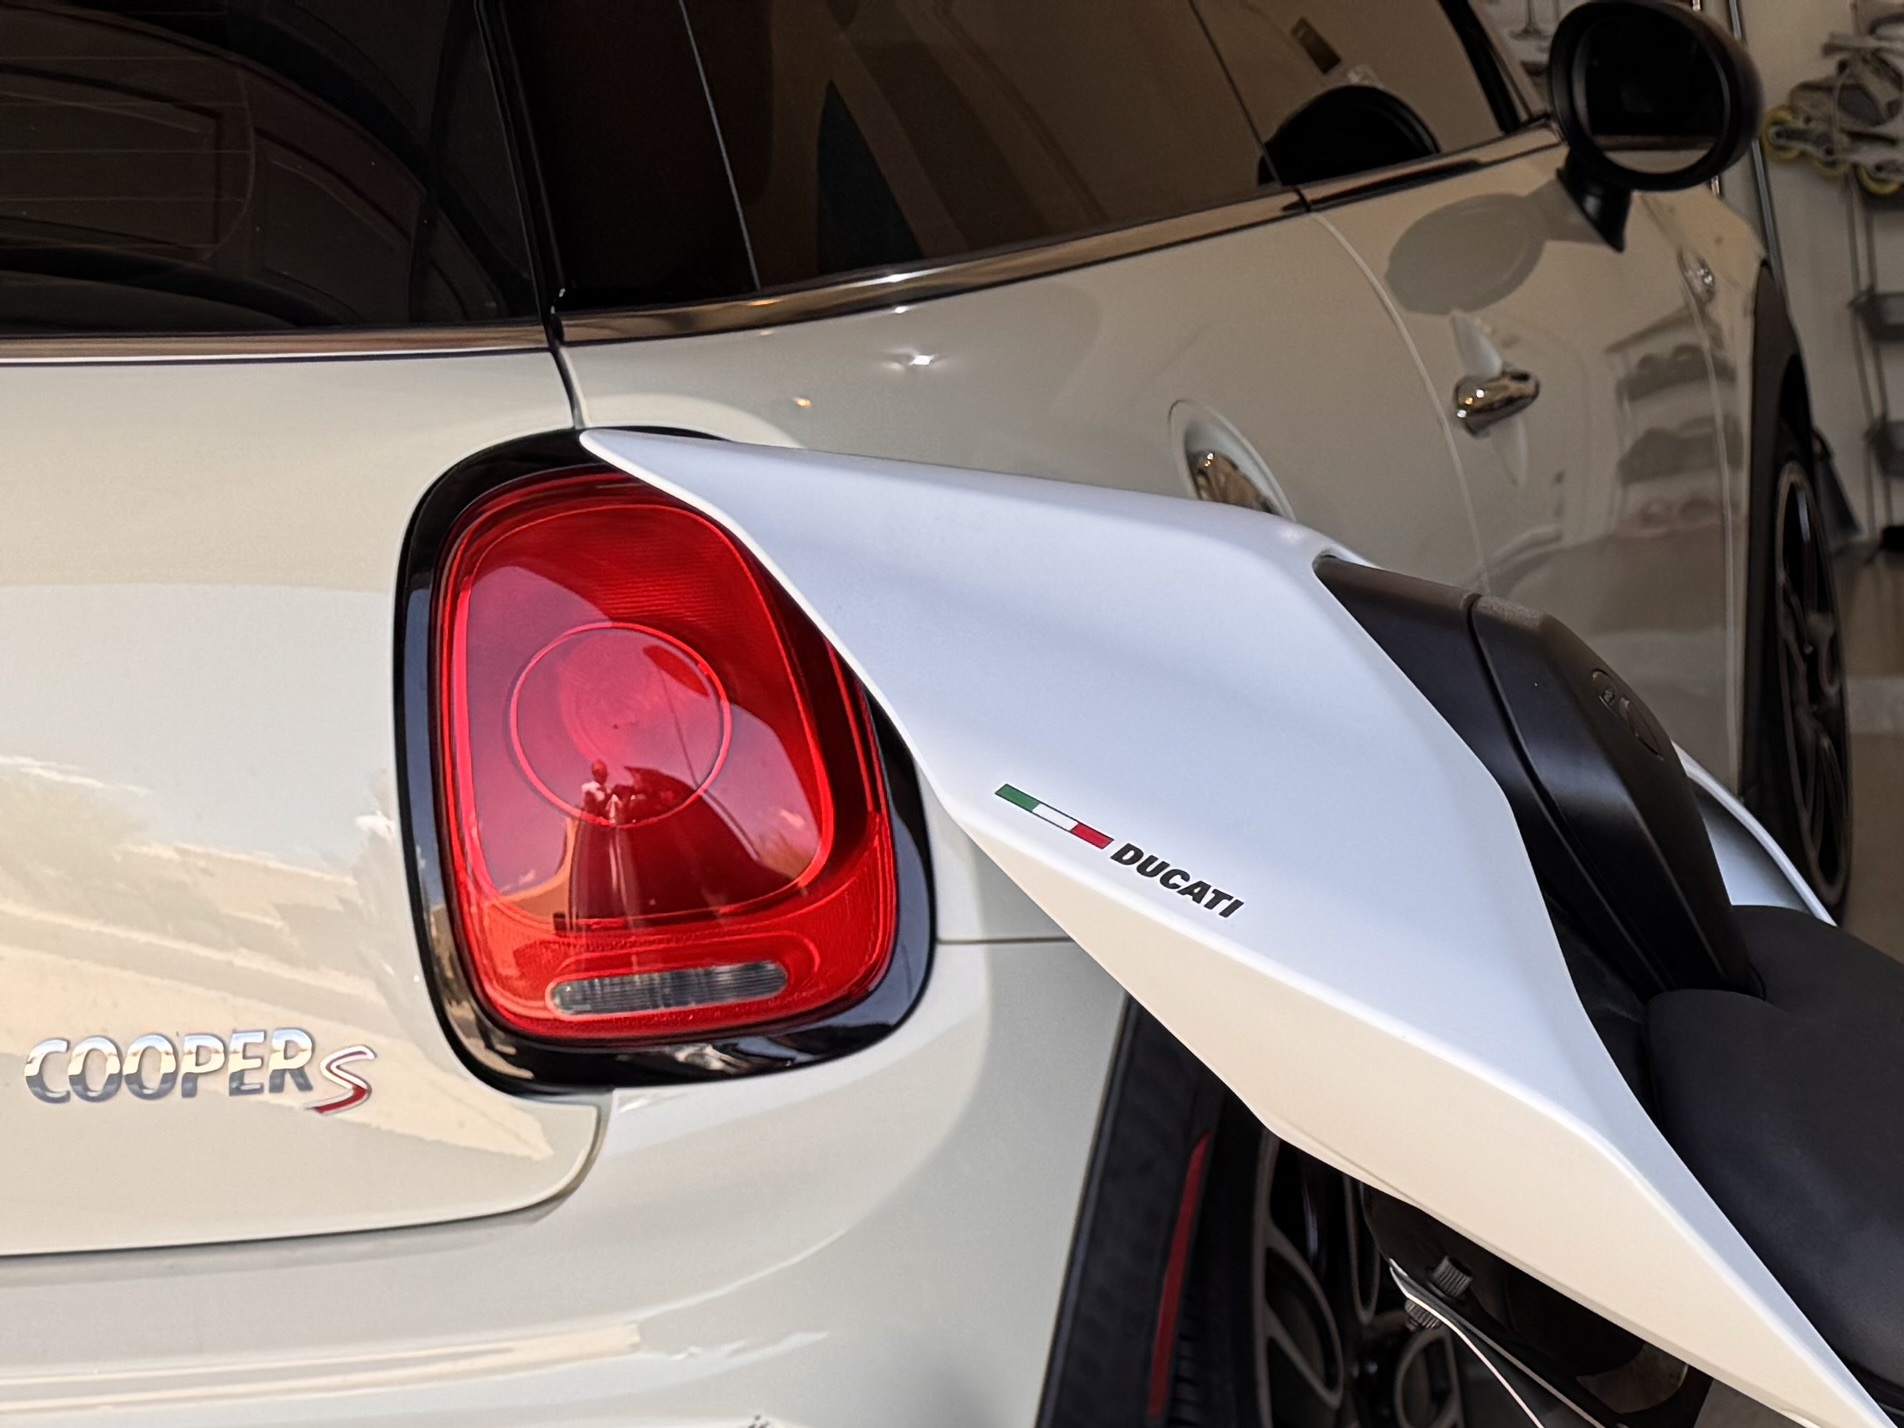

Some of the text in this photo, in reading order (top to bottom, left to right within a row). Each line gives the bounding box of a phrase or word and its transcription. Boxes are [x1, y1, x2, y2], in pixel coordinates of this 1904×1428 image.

[1110, 842, 1245, 919] DUCATI
[23, 1026, 378, 1116] COOPER S
